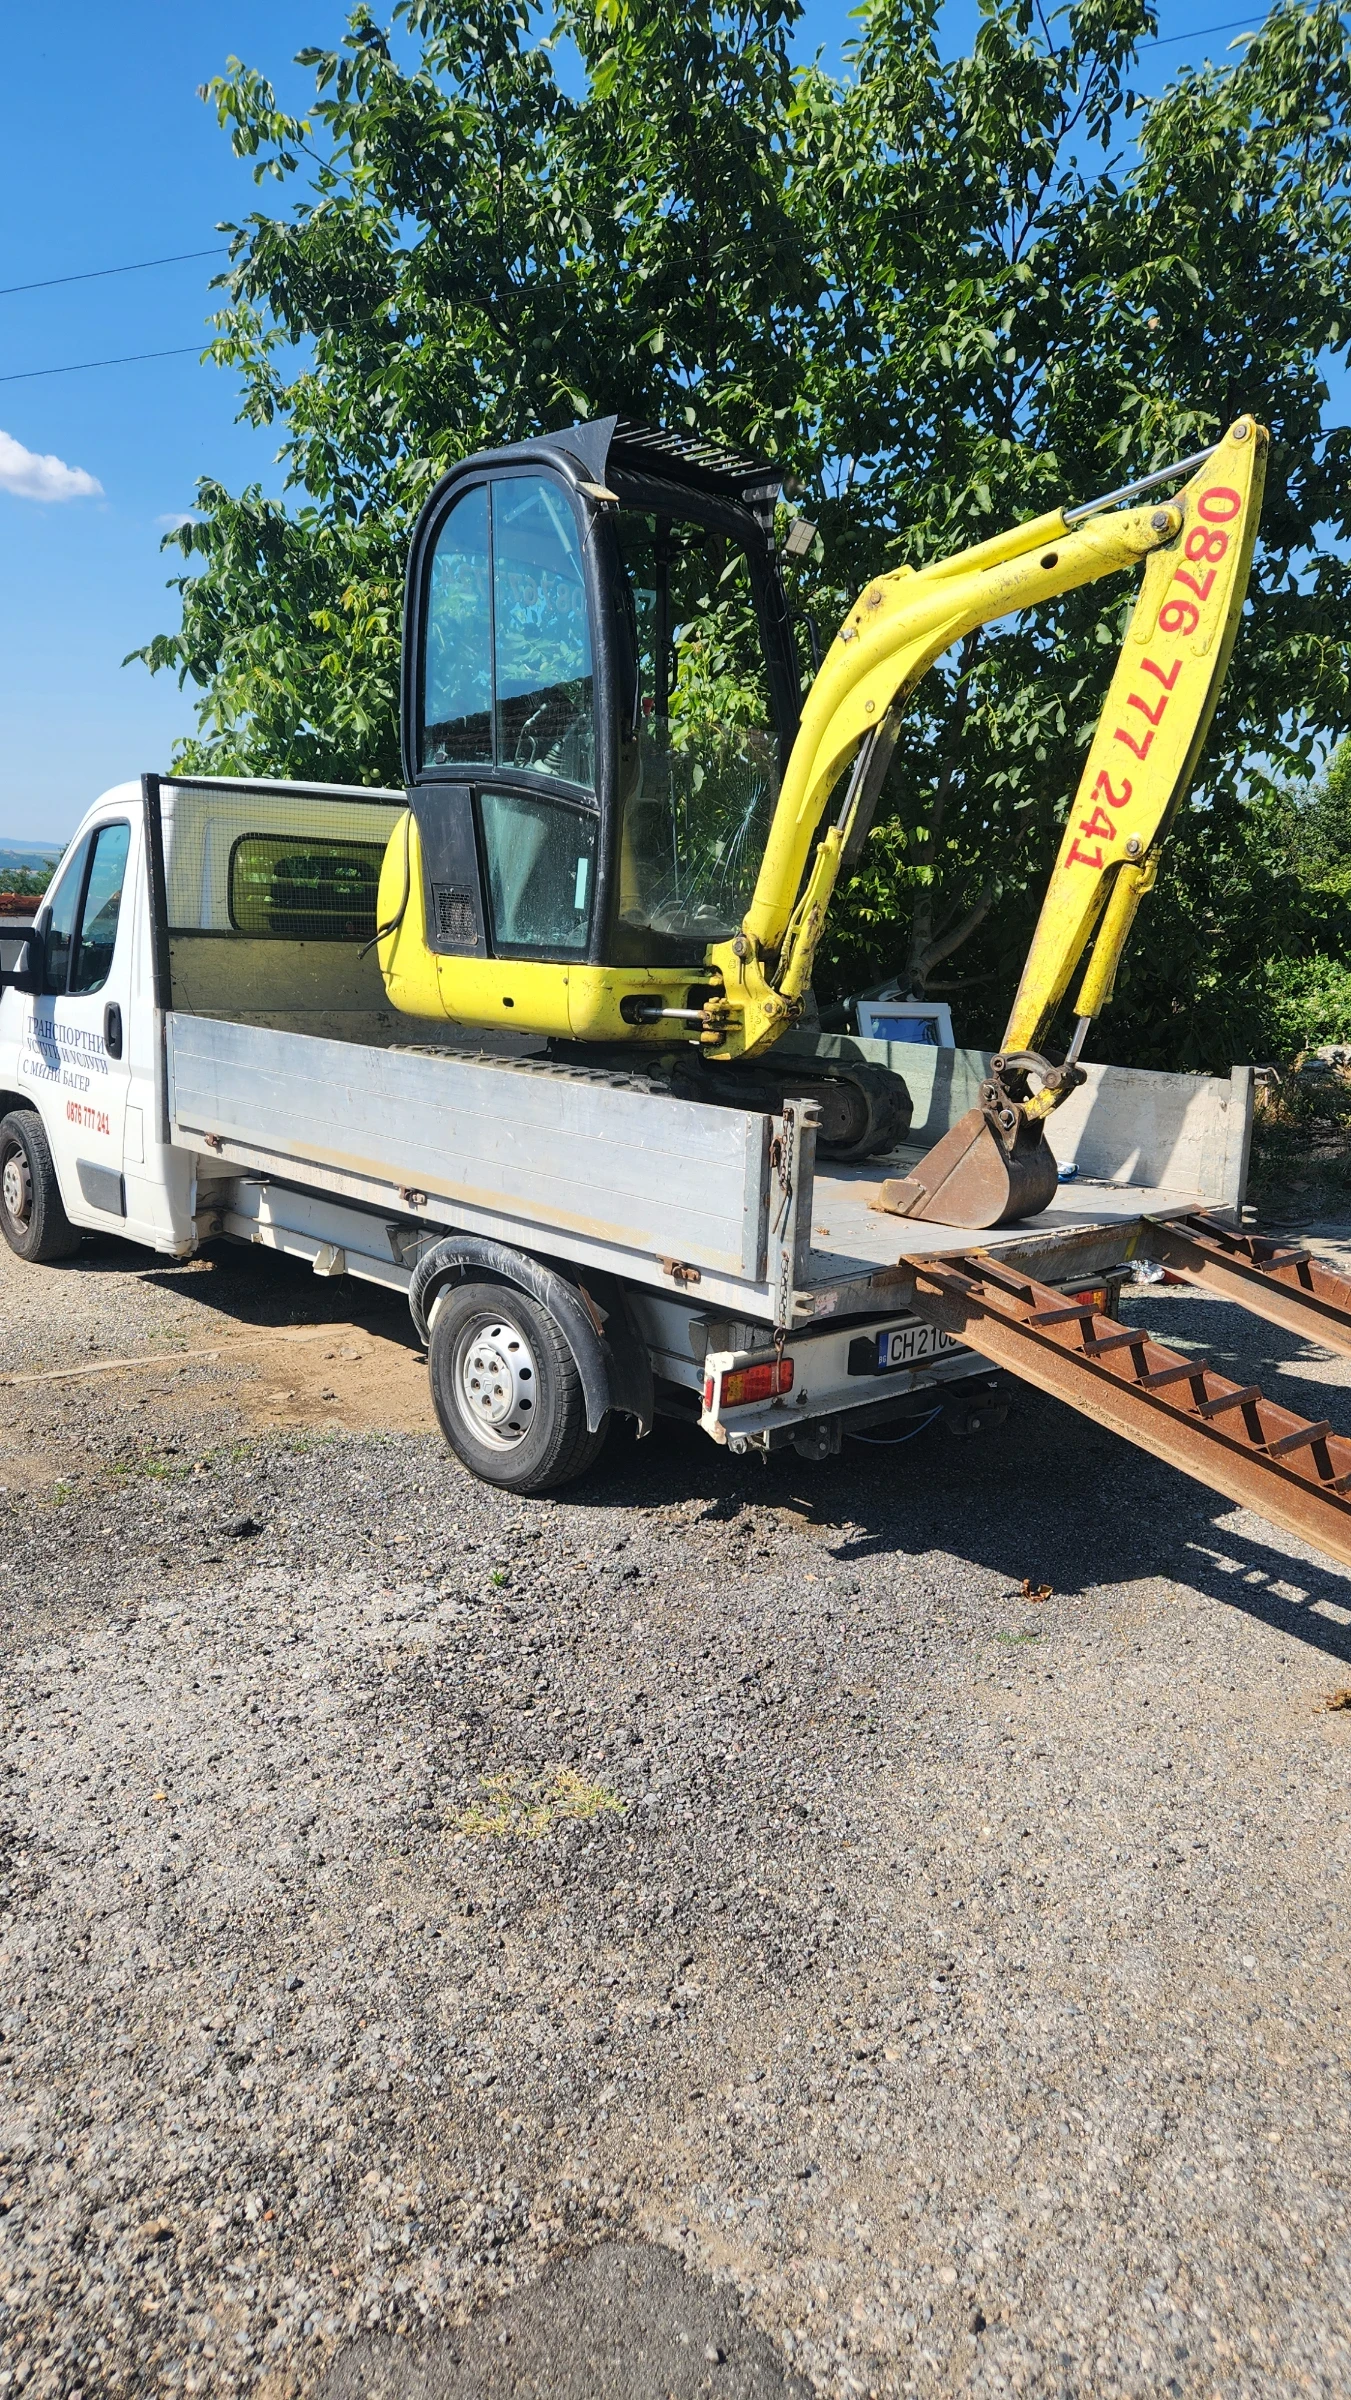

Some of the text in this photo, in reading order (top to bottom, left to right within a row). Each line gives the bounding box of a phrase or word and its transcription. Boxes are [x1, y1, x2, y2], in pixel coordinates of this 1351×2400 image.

[1064, 486, 1241, 870] 0876 777 241
[28, 1016, 106, 1055] ТРАНСПОРТНИ
[27, 1037, 109, 1075] УСЛУГИ И УСЛУГИ
[22, 1058, 90, 1092] С МИНИ БАГЕР
[66, 1100, 110, 1135] 0876 777 241
[878, 1354, 887, 1365] BG
